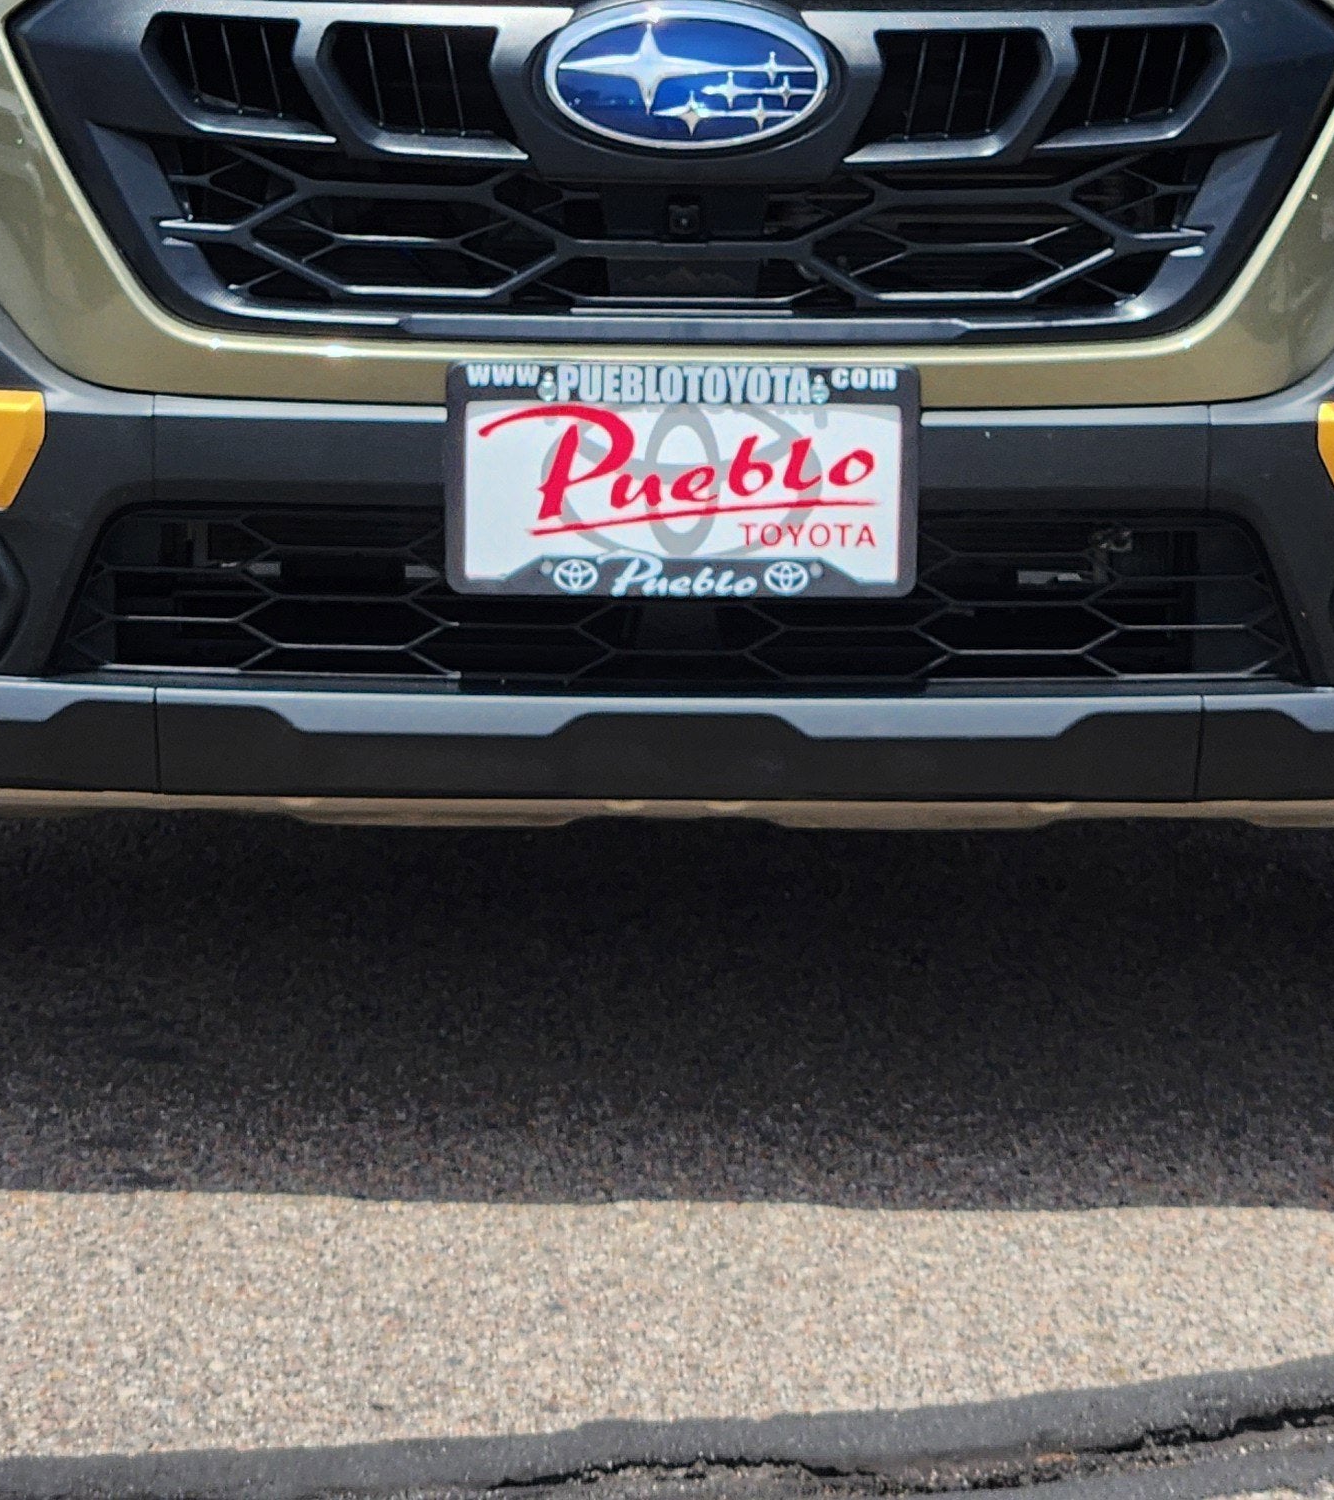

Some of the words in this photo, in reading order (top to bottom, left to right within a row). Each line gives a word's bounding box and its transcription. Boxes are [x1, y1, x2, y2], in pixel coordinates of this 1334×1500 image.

[478, 404, 875, 521] Pueblo
[738, 522, 877, 548] TOYOTA
[596, 549, 758, 597] Pueblo
